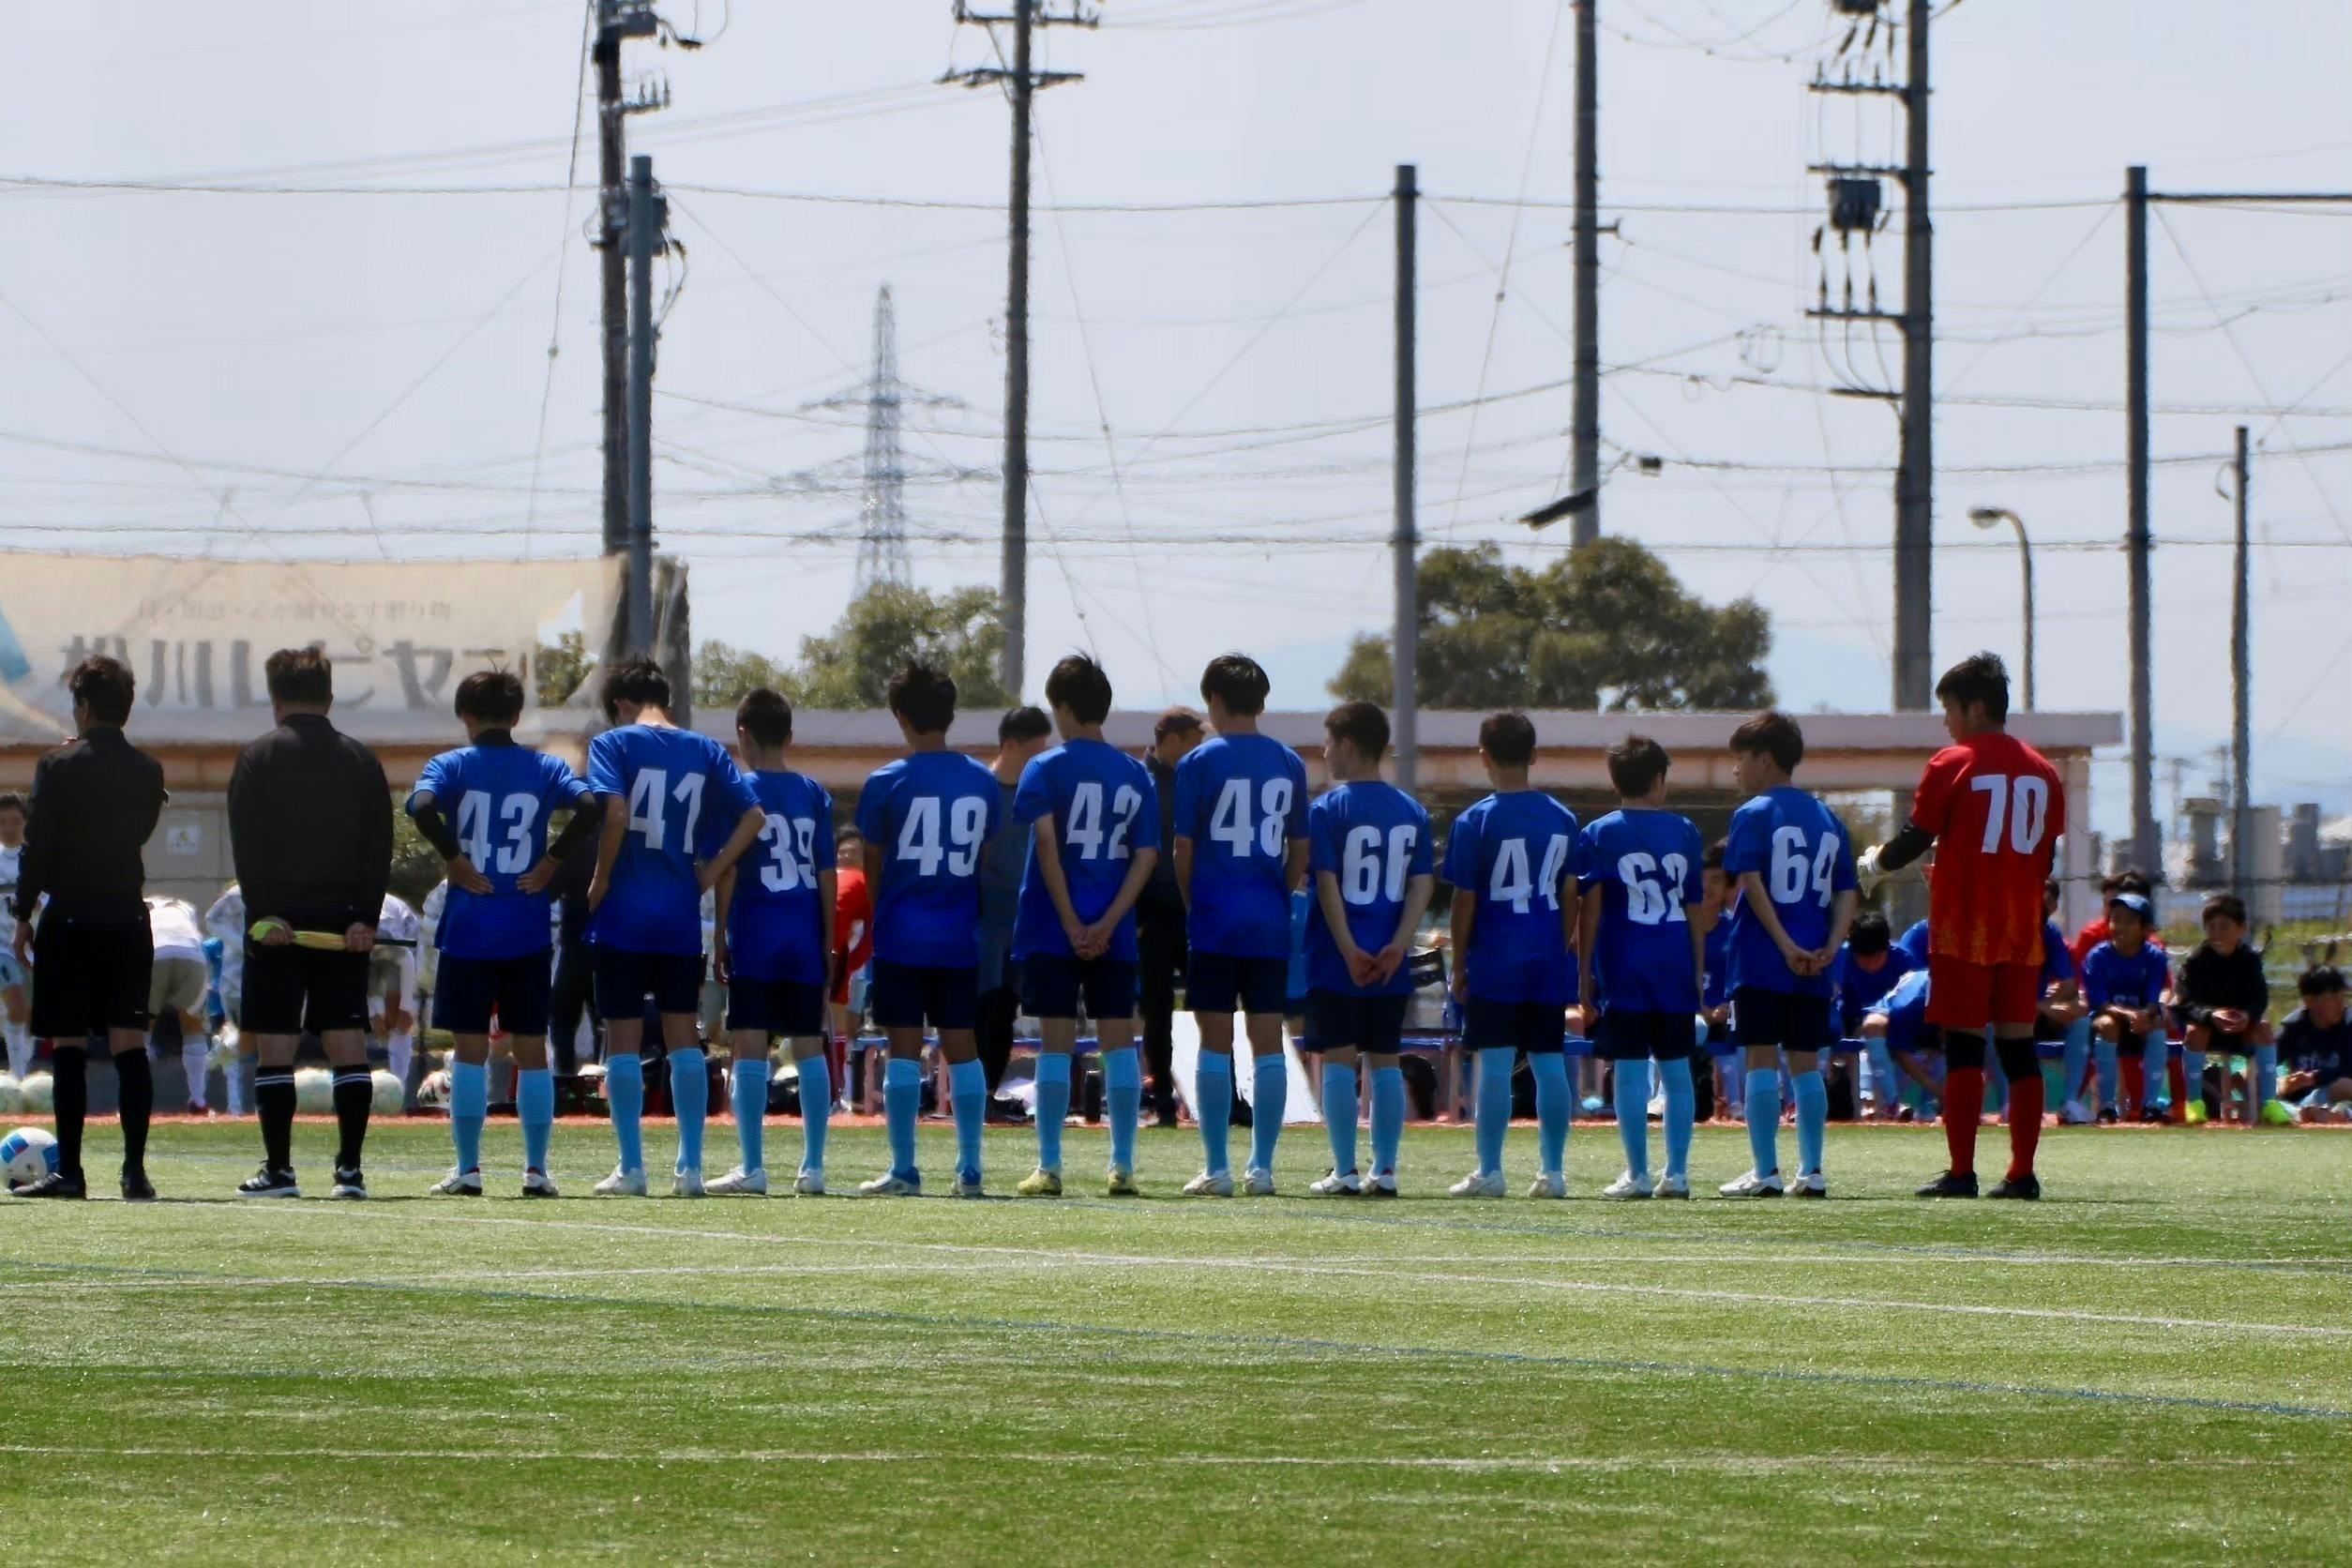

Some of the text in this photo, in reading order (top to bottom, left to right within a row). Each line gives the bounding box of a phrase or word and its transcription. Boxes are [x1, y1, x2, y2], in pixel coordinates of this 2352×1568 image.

[457, 791, 540, 874] 43
[629, 768, 706, 853] 41
[897, 796, 988, 877] 49
[1066, 781, 1141, 859] 42
[1210, 777, 1293, 857] 48
[1970, 775, 2048, 854] 70
[757, 813, 819, 893] 39
[1342, 824, 1417, 905] 66
[1490, 834, 1569, 913] 44
[1618, 852, 1688, 925] 62
[1770, 826, 1840, 908] 64
